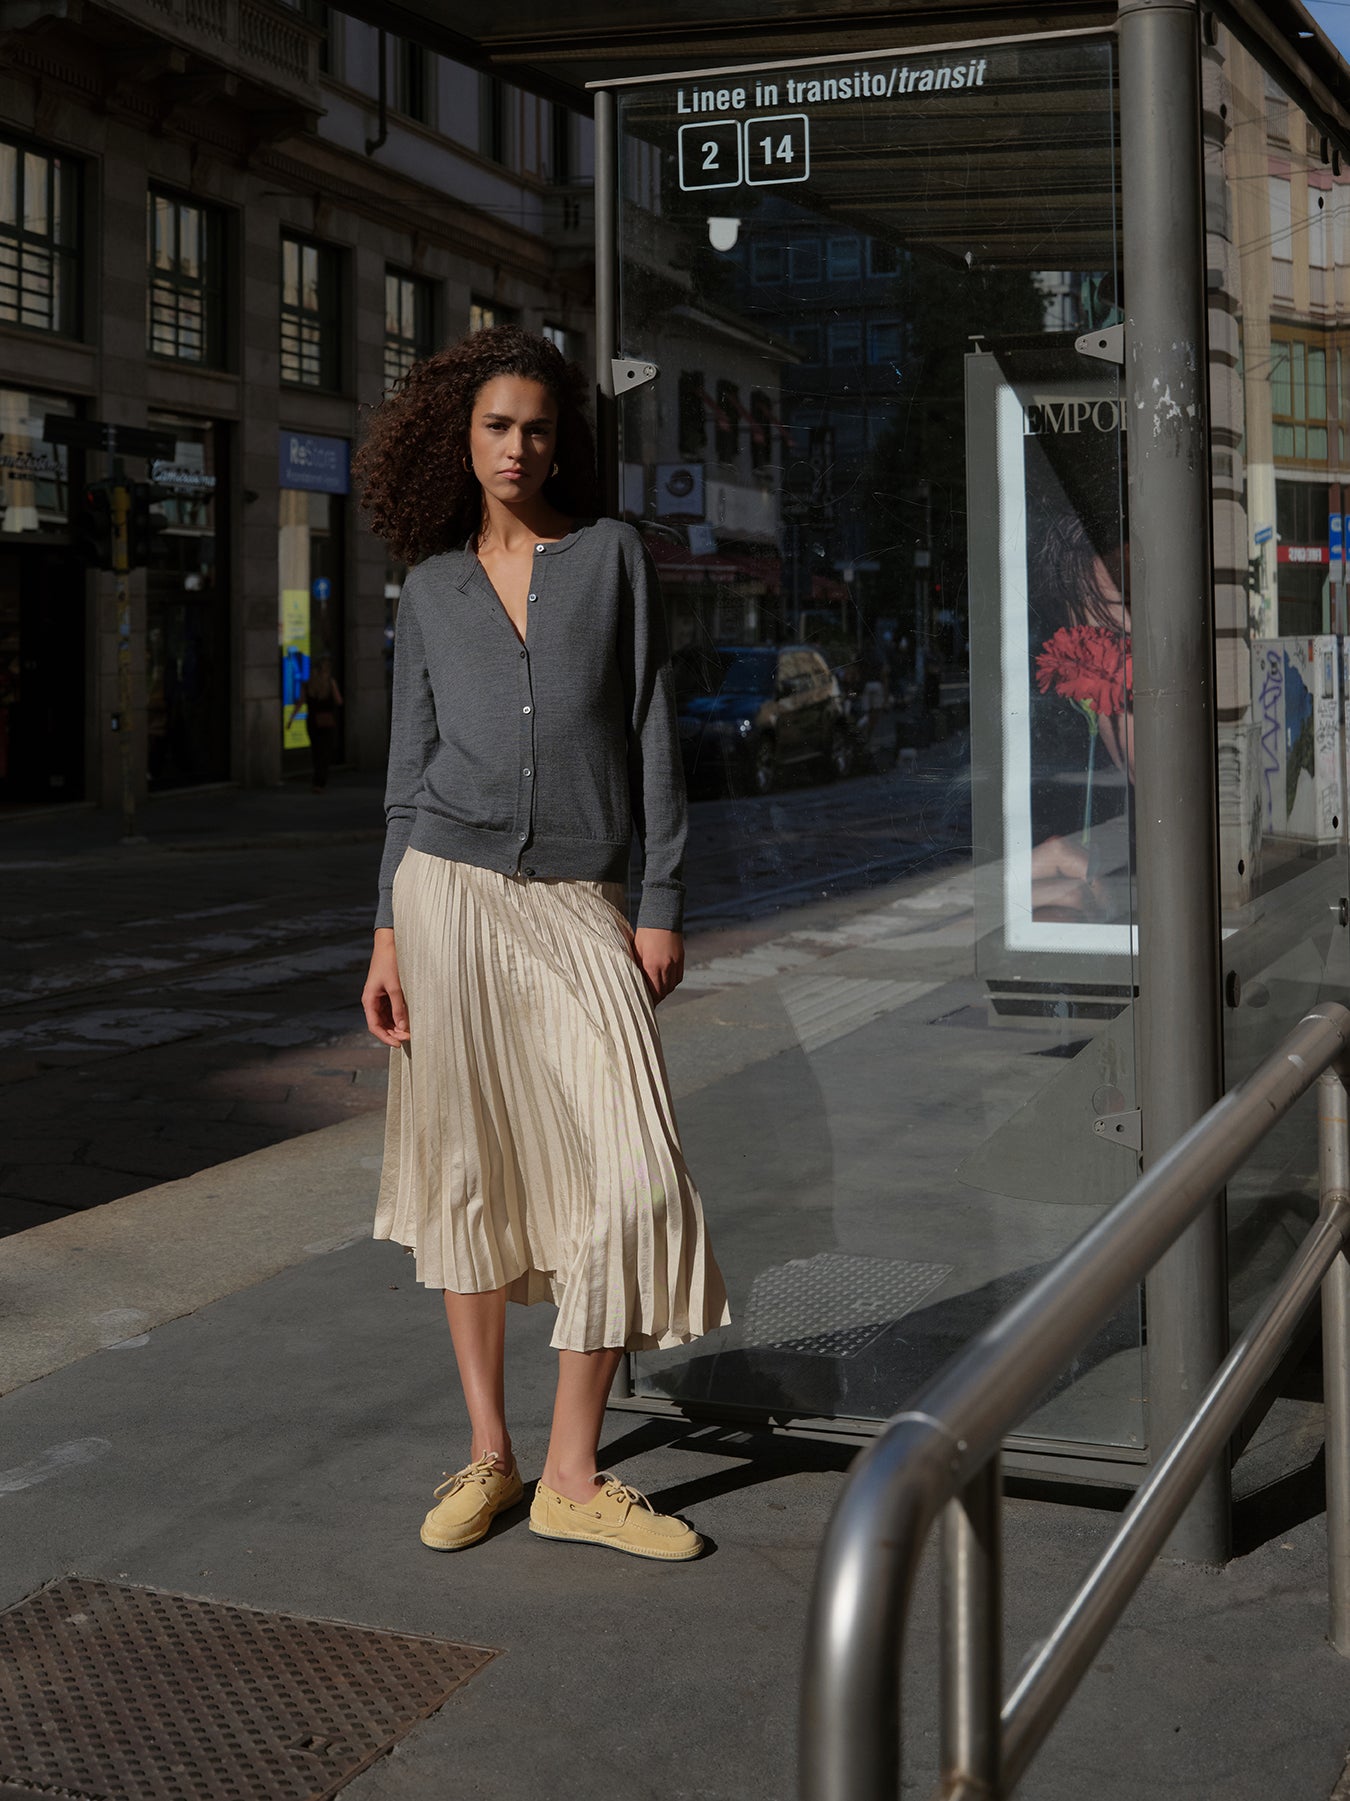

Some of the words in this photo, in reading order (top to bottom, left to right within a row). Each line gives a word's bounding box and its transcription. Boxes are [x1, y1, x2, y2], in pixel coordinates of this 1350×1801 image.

[677, 87, 746, 114] Linee
[755, 80, 779, 106] in
[786, 59, 987, 104] transito/transit
[701, 141, 719, 170] 2
[759, 134, 794, 165] 14
